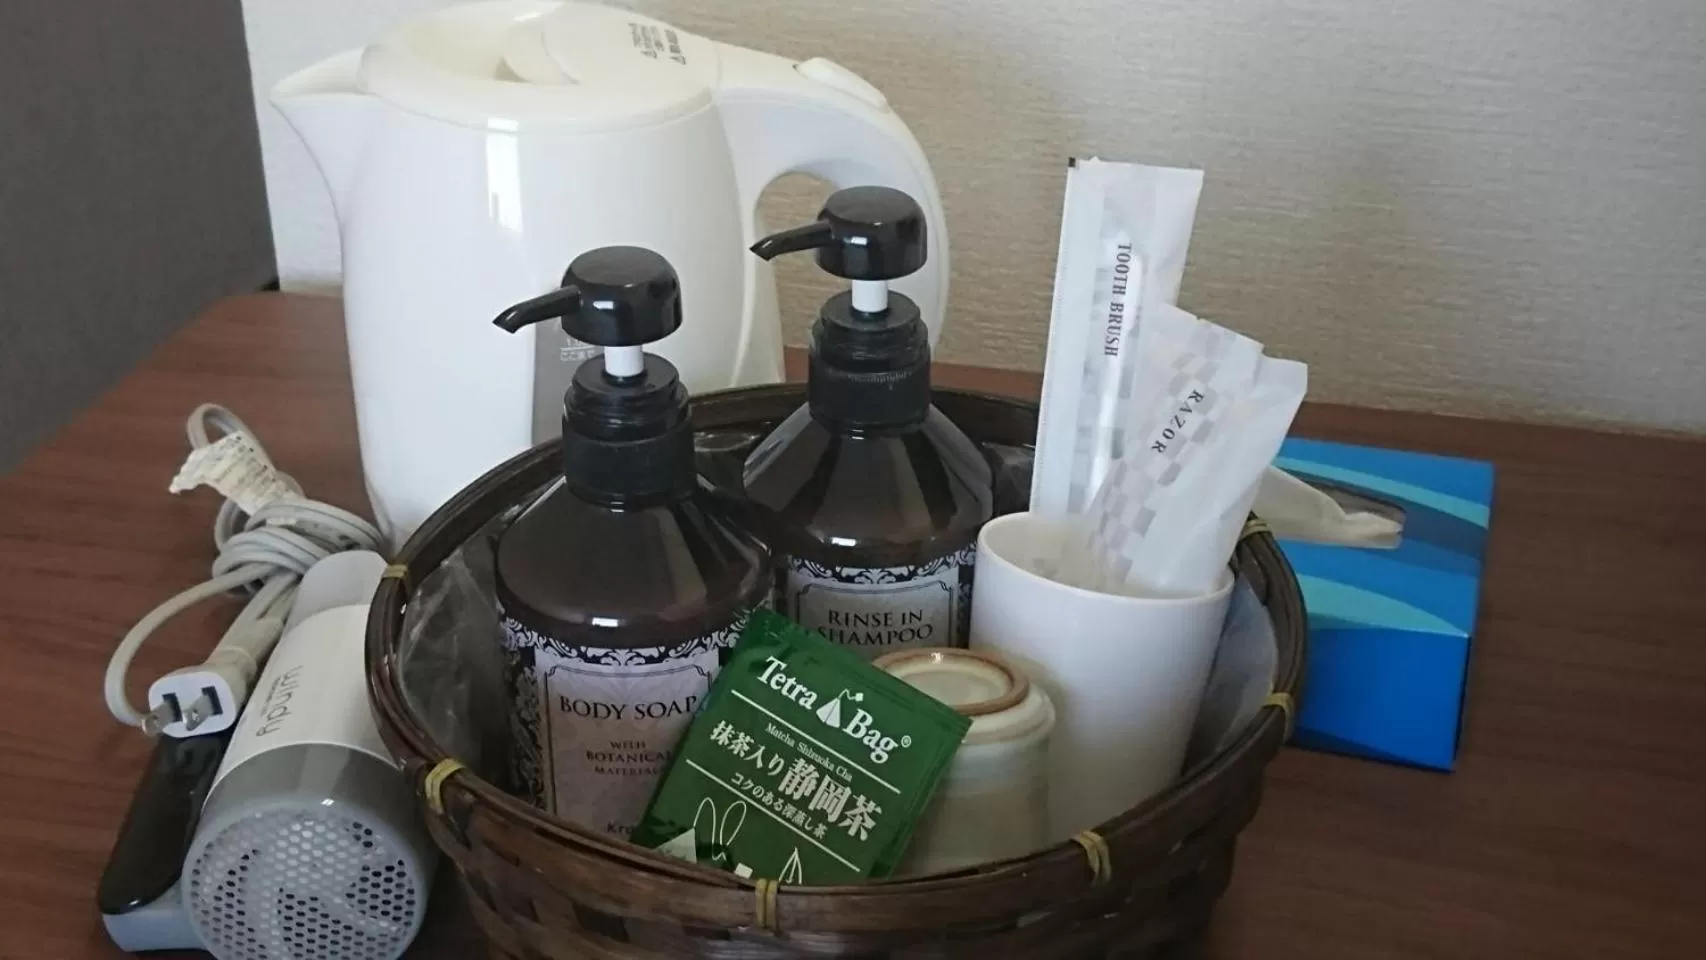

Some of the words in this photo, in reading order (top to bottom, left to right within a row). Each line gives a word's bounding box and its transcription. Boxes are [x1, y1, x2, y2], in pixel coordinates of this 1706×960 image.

[1111, 242, 1132, 295] TOOTH
[1104, 301, 1125, 357] BRUSH
[1152, 389, 1205, 454] RAZOR
[818, 623, 934, 646] SHAMPOO
[828, 609, 893, 628] RINSE
[901, 608, 923, 626] IN
[559, 695, 626, 720] BODY
[633, 695, 697, 721] SOAP
[756, 655, 818, 710] Tetra
[609, 740, 646, 749] WITH
[765, 722, 796, 748] Matcha
[797, 741, 835, 772] Shizuoka
[836, 765, 853, 783] Cha
